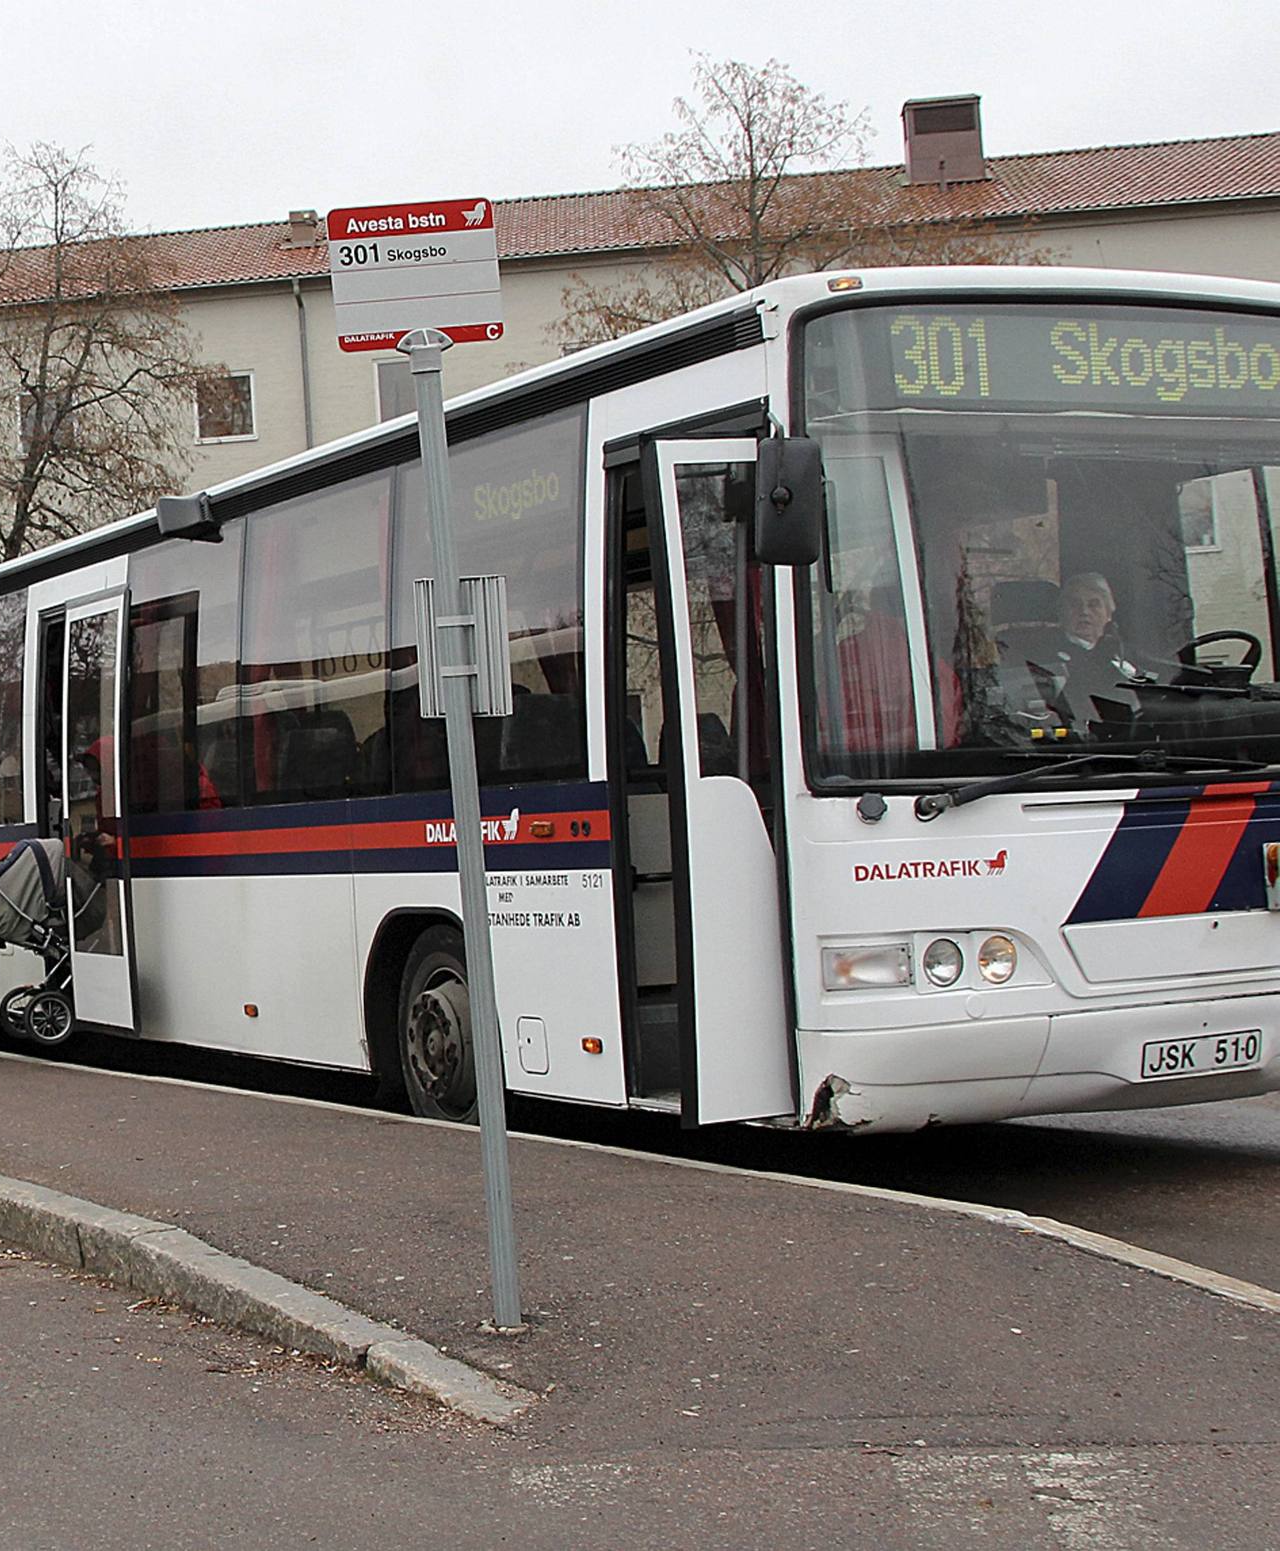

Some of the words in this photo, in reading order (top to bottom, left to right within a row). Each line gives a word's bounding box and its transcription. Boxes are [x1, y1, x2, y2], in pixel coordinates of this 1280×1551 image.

[346, 216, 404, 234] Avesta
[408, 213, 446, 228] bstn
[339, 243, 380, 266] 301
[387, 245, 447, 262] Skogsbo
[344, 332, 395, 344] DALATRAFIK
[486, 324, 500, 340] C
[890, 315, 990, 397] 301
[1050, 321, 1280, 401] Skogsbo
[472, 468, 560, 520] Skogsbo
[426, 820, 501, 843] DALAFIK
[486, 875, 518, 887] LATRAFIK
[526, 874, 569, 887] SAMARBETE
[581, 873, 604, 889] 5121
[854, 859, 981, 882] DALATRAFIK
[488, 912, 530, 927] STANHEDE
[533, 912, 565, 927] TRAFIK
[567, 912, 581, 927] AB
[1149, 1042, 1196, 1073] JSK
[1214, 1034, 1258, 1064] 510
